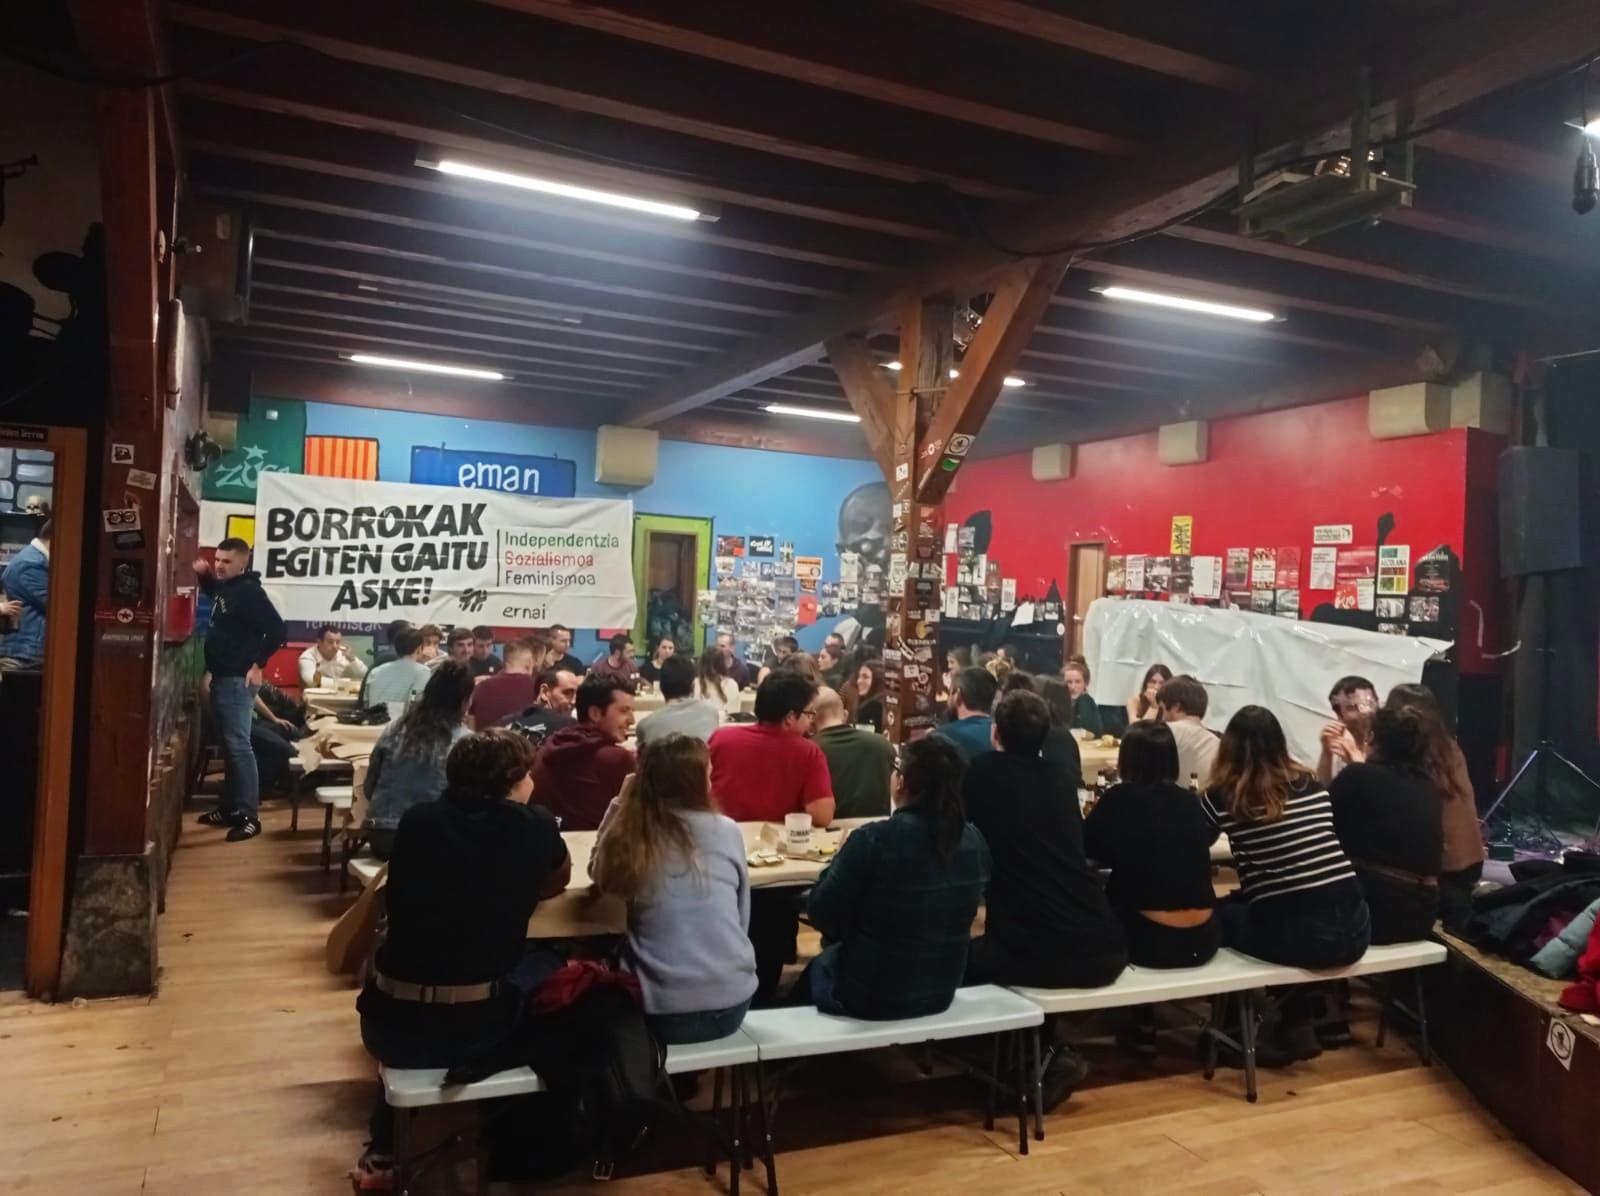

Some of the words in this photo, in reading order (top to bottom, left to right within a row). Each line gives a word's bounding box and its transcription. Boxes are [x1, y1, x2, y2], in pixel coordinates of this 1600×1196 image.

[458, 460, 540, 493] eman
[267, 503, 487, 542] BORROKAK
[505, 532, 620, 549] Independentzia
[266, 545, 384, 578] EGITEN
[391, 542, 488, 572] GAITU
[505, 552, 594, 567] Sozialismoa
[505, 570, 596, 585] Feminismoa
[331, 578, 432, 612] ASKE!
[502, 604, 546, 620] ernai
